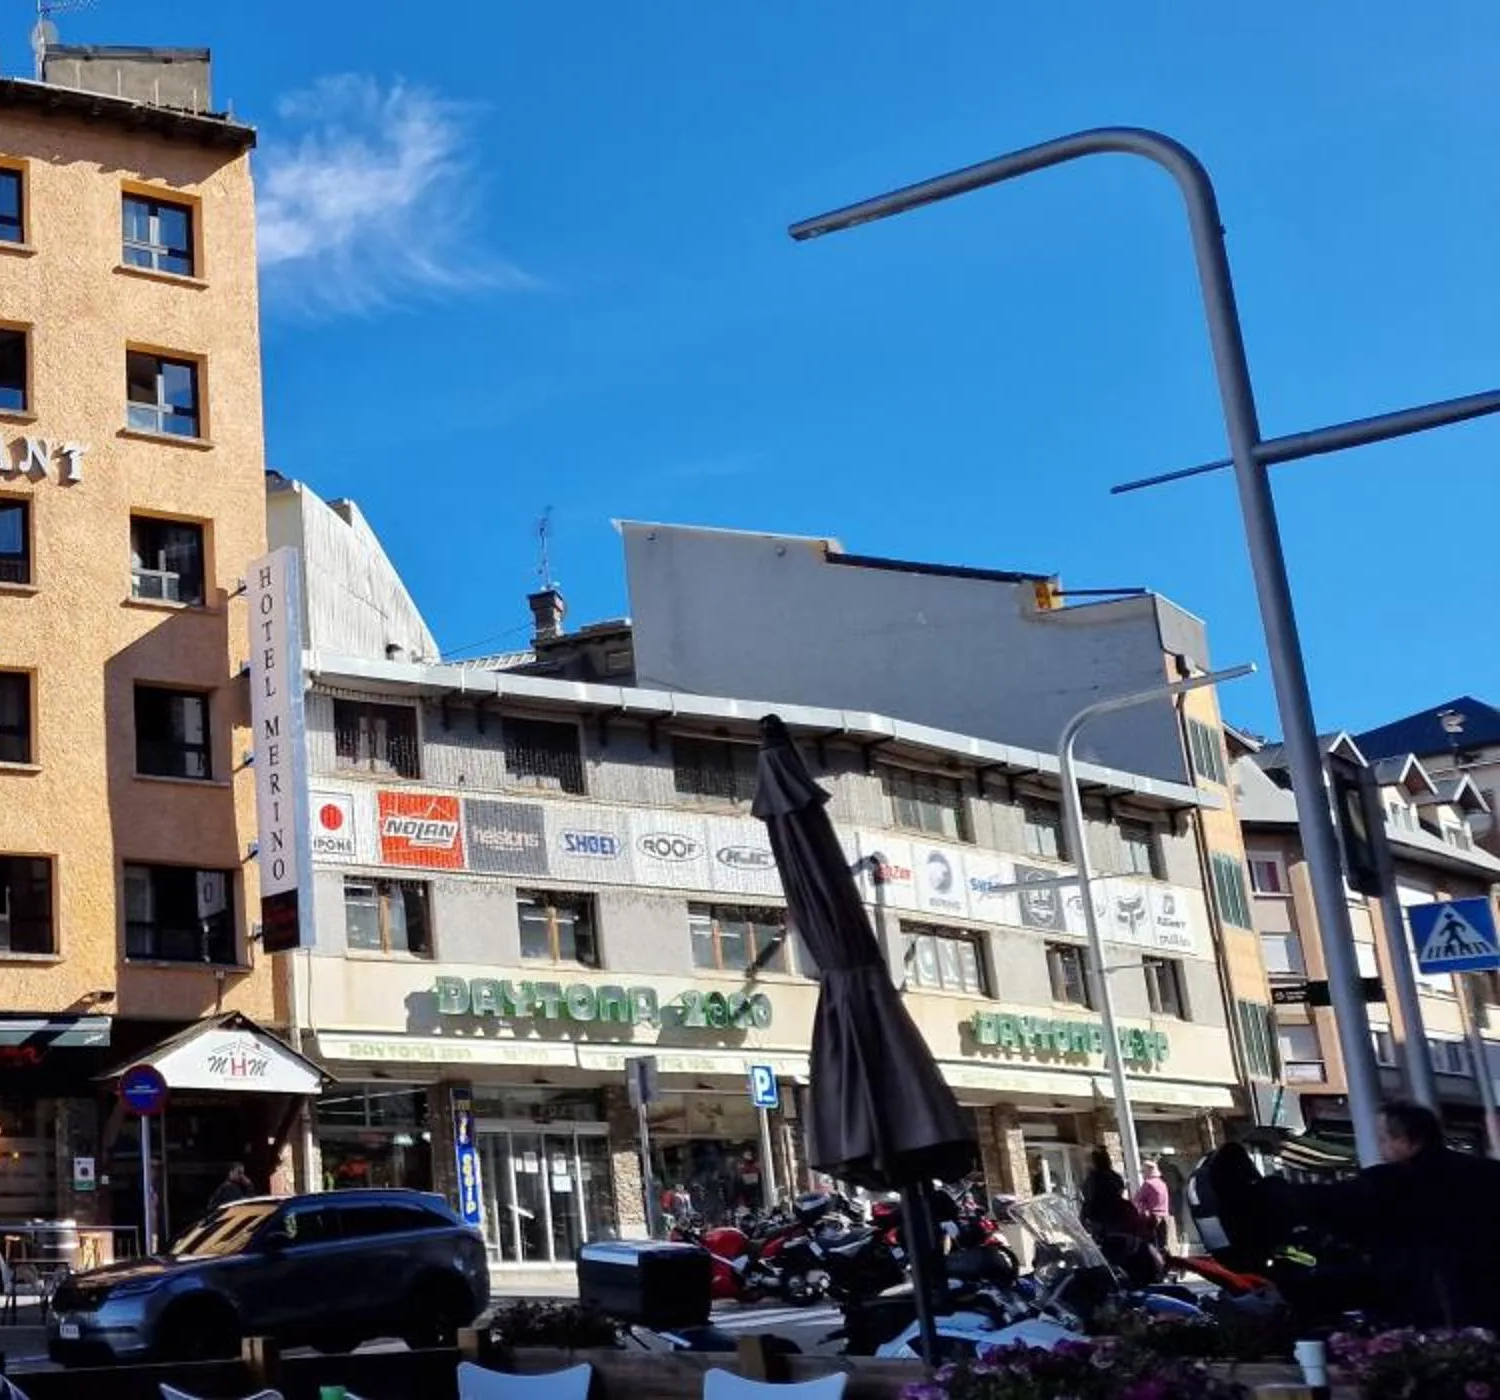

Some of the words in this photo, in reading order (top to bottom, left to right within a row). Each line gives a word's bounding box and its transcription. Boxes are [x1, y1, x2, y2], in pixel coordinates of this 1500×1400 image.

[258, 567, 278, 698] HOTEL
[264, 716, 286, 881] MERINO
[385, 818, 456, 840] NOLAN
[563, 833, 616, 855] SHOEI
[642, 837, 697, 858] ROOF
[436, 975, 661, 1030] DAYTONA
[678, 989, 773, 1029] 2000
[753, 1068, 771, 1102] P
